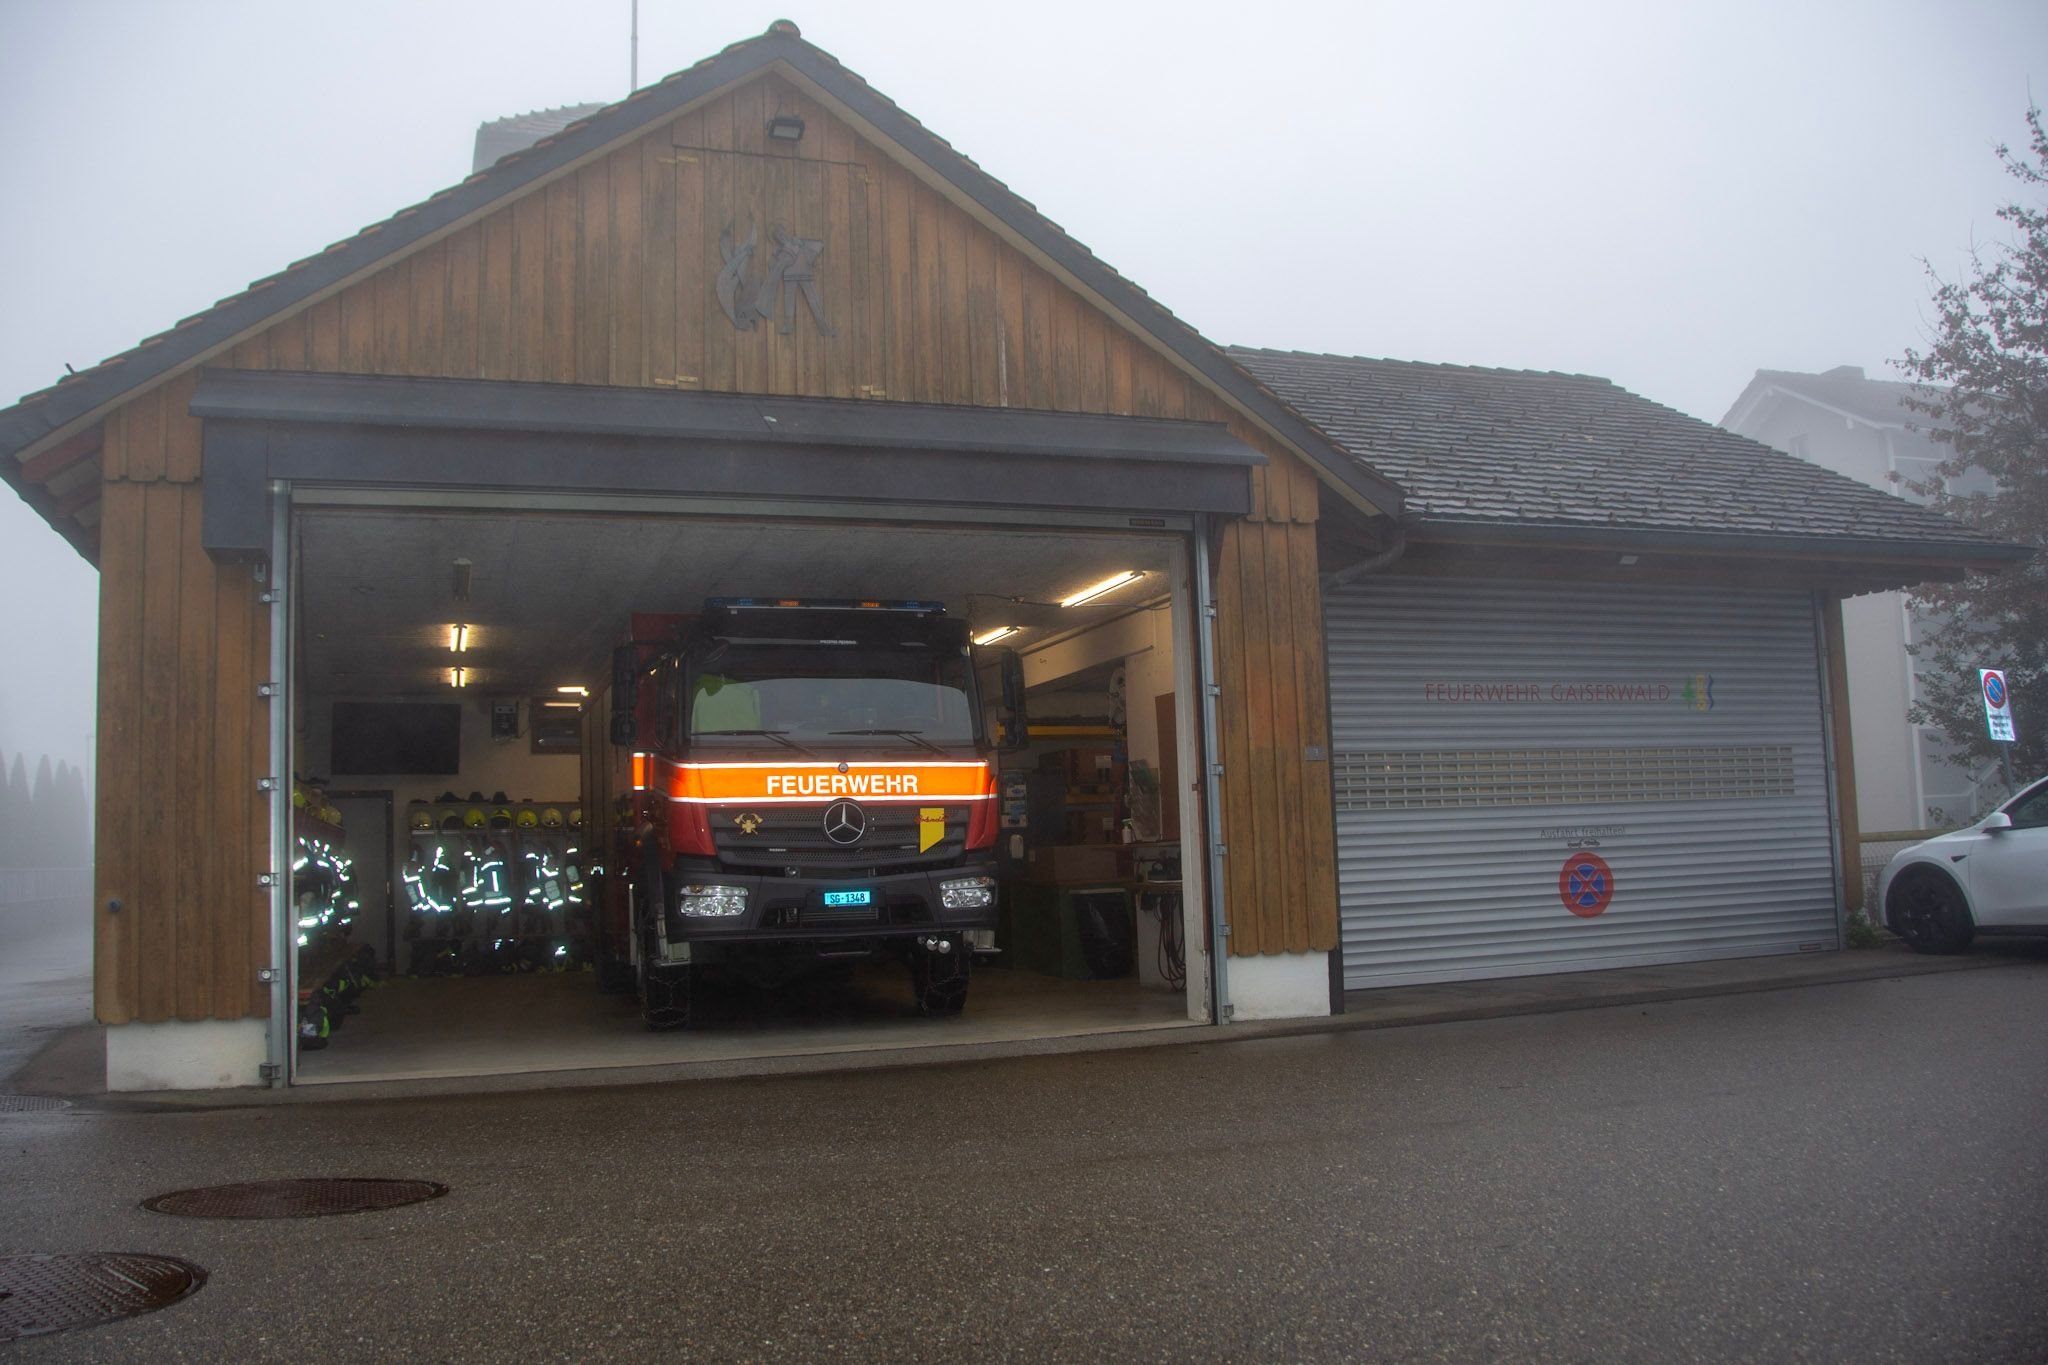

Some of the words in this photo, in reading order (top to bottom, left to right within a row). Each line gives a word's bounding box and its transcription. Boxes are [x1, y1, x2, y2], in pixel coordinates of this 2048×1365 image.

[1425, 684, 1542, 702] FEUERWEHR
[1551, 684, 1670, 702] GAISERWALD
[767, 775, 918, 794] FEUERWEHR
